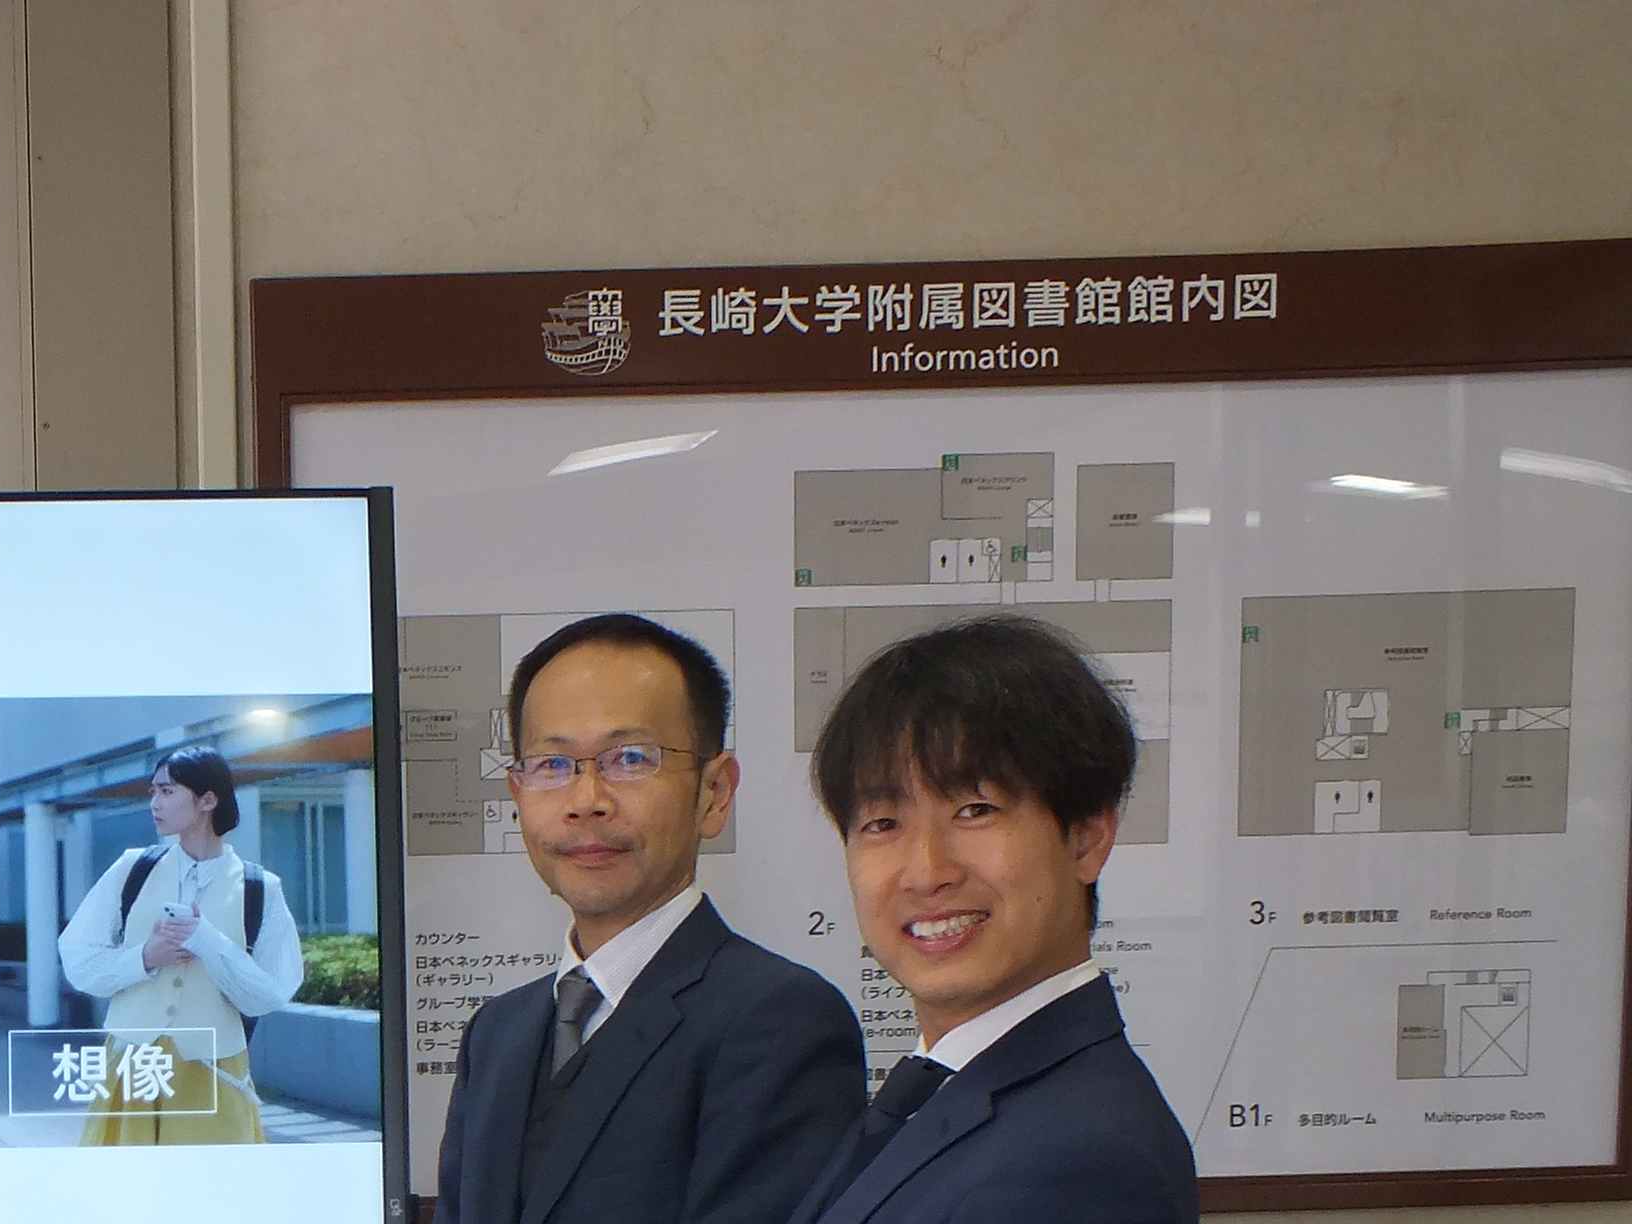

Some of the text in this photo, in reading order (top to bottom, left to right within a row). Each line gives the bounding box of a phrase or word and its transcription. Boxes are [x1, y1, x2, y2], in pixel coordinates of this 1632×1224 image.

[658, 273, 1279, 337] 長崎大学附属図書館館内図
[872, 341, 1060, 373] Information
[1430, 907, 1532, 921] Reference Room
[415, 932, 481, 946] カウンター
[1116, 940, 1152, 952] Room
[415, 953, 563, 969] 日本ベネックスギャラリ
[416, 995, 492, 1011] グループ学
[52, 1043, 175, 1103] 想像
[1298, 1112, 1377, 1127] 多目的ルーム
[1424, 1108, 1546, 1125] Multipurpose Room
